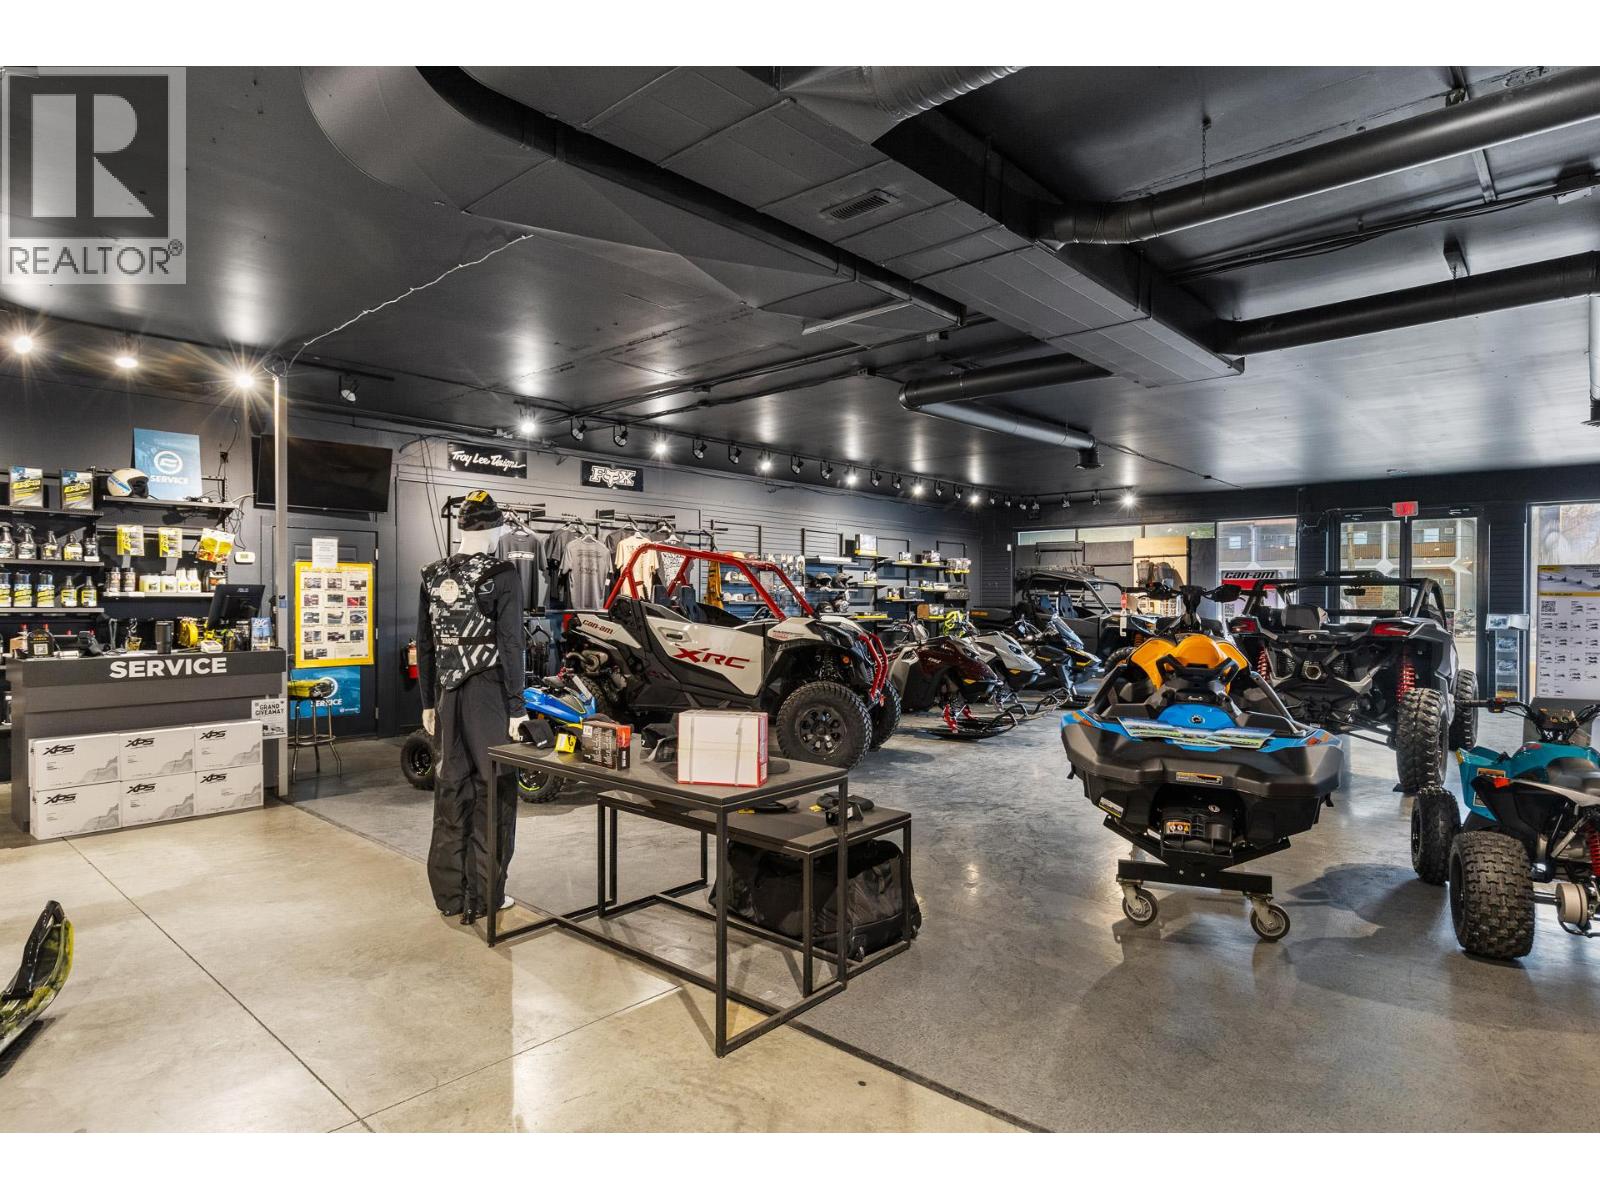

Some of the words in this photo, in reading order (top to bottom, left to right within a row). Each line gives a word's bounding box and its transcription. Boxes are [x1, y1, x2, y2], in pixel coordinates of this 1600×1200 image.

[451, 450, 471, 467] Troy
[472, 453, 490, 464] Lee
[490, 455, 526, 471] Designs
[150, 475, 190, 485] SERVICE
[1224, 571, 1275, 579] can-am
[582, 619, 615, 635] can-am
[673, 644, 750, 669] XRC
[109, 657, 227, 679] SERVICE
[254, 708, 284, 716] GIVEAWAY
[200, 730, 227, 740] XPS
[125, 737, 155, 748] XPS
[42, 744, 76, 756] XPS
[200, 773, 227, 784] XPS
[126, 783, 156, 794] XPS
[44, 793, 76, 805] XPS
